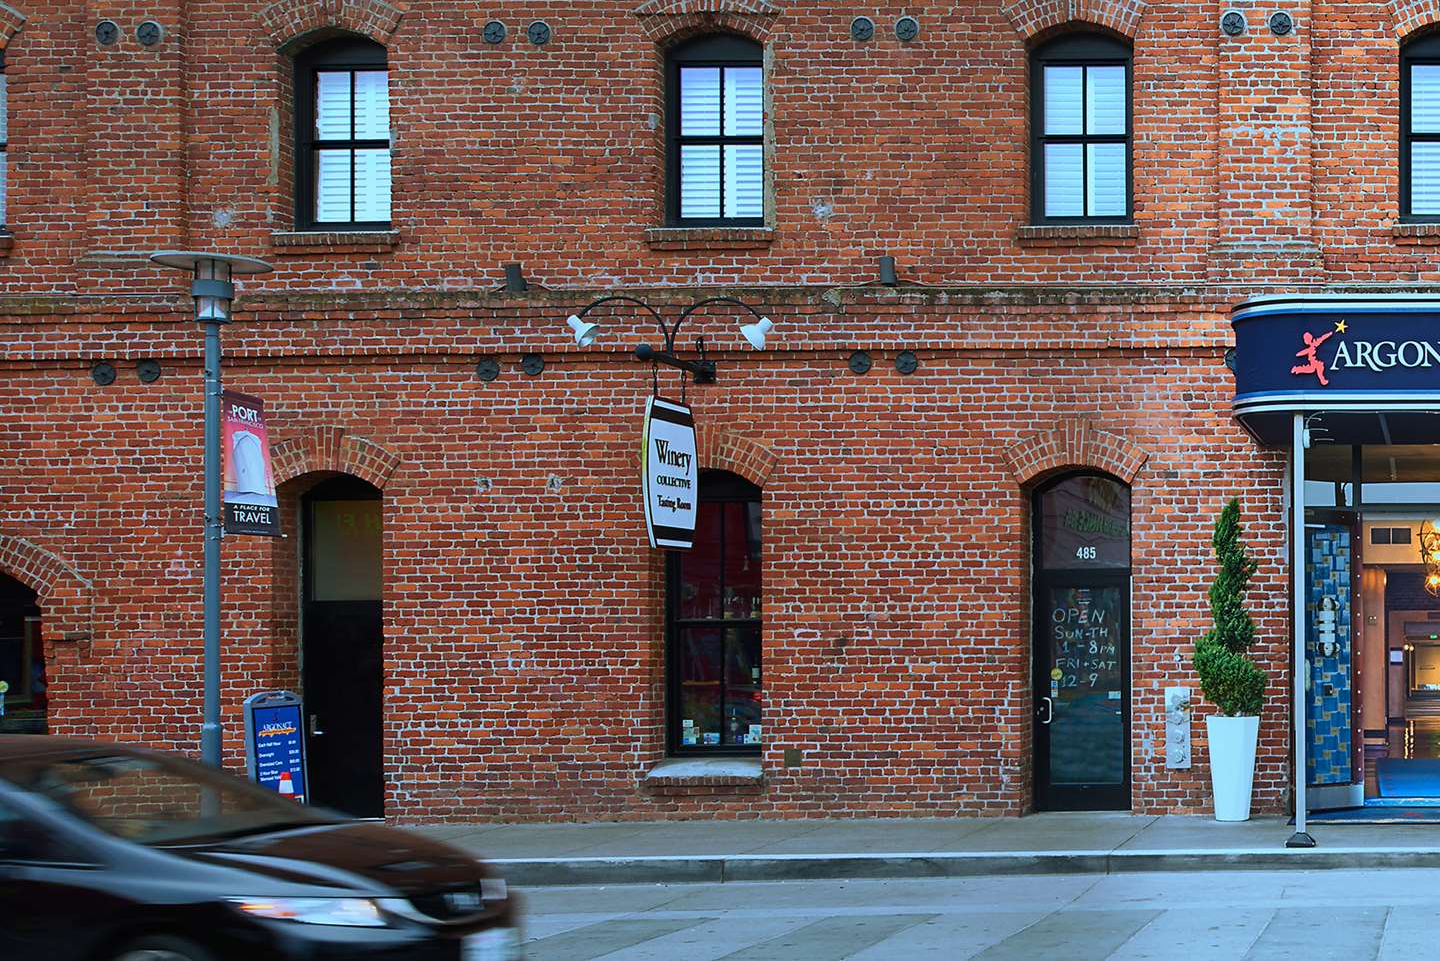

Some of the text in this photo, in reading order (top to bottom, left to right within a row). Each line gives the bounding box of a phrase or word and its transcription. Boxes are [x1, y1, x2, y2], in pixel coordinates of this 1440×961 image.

[231, 404, 258, 423] PORT
[654, 438, 692, 476] Winery
[656, 474, 691, 489] COLLECTIVE
[657, 494, 692, 513] Tasting Room
[233, 510, 272, 525] TRAVEL
[1076, 546, 1096, 559] 485
[1052, 608, 1105, 624] OPEN
